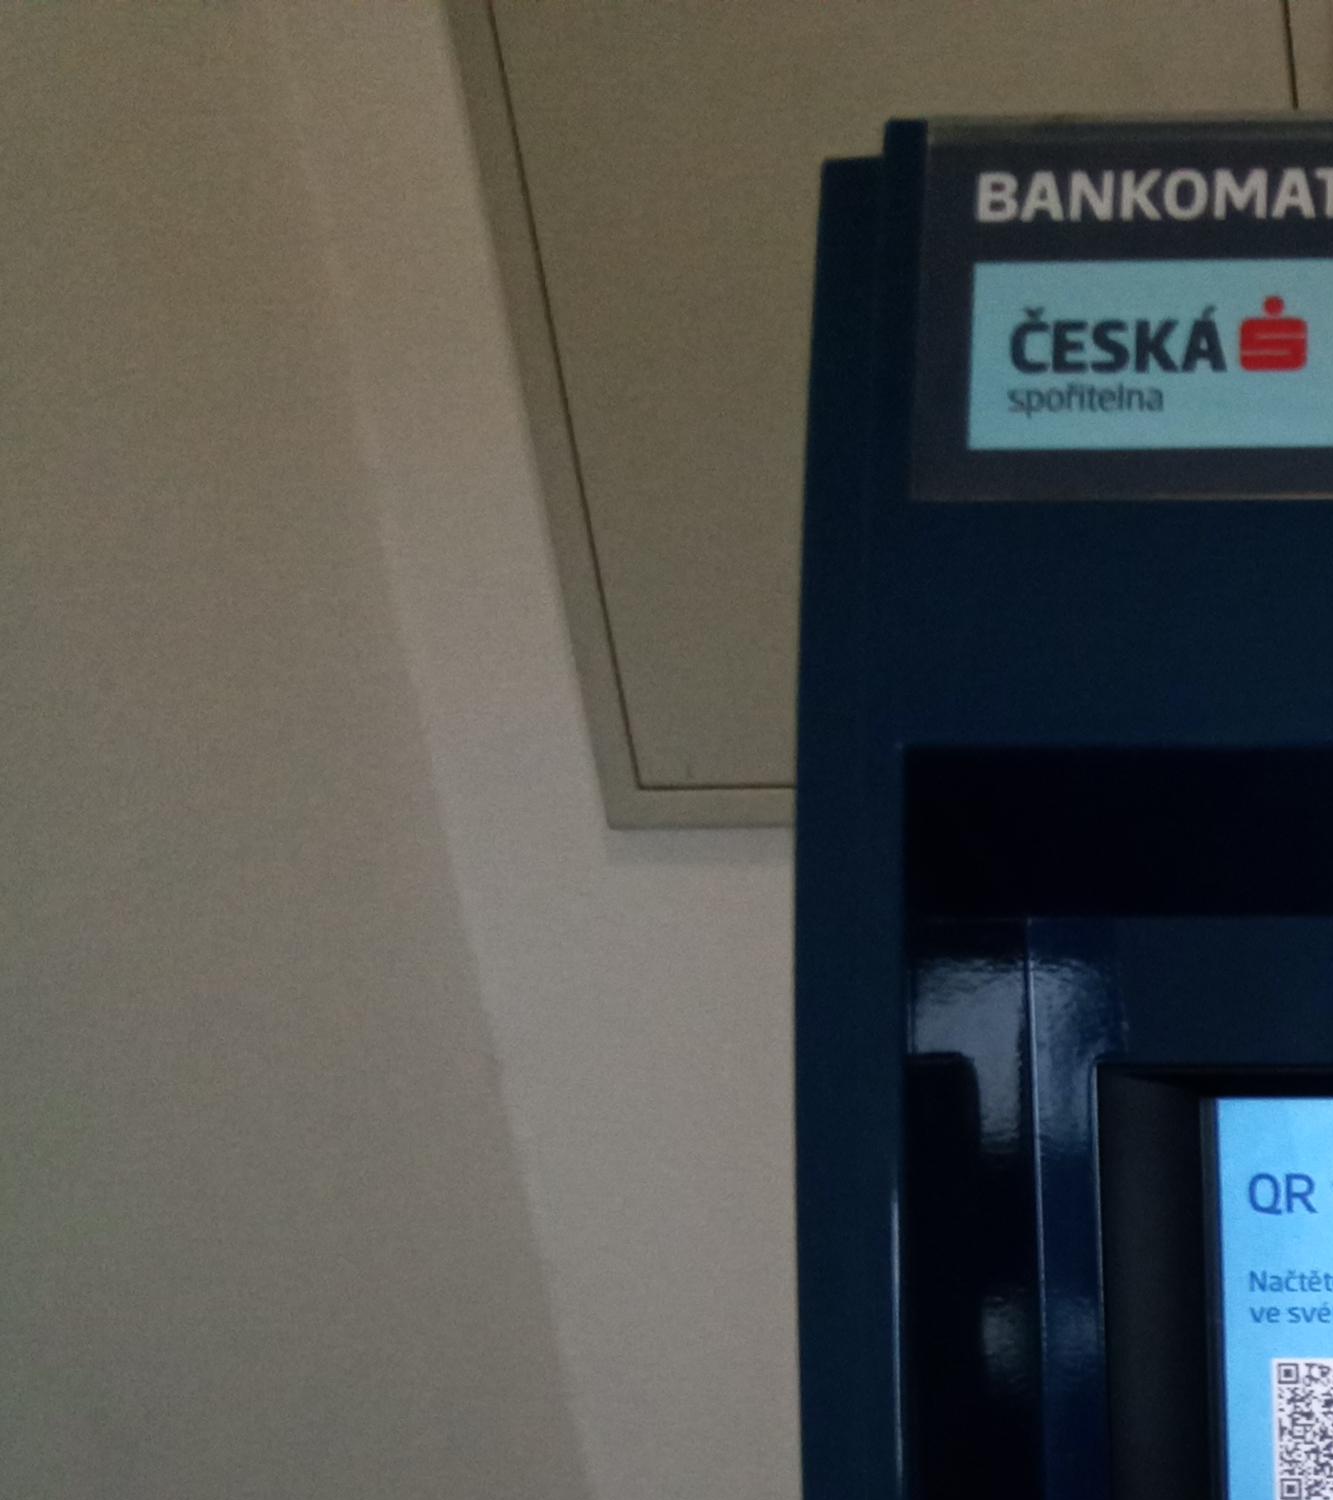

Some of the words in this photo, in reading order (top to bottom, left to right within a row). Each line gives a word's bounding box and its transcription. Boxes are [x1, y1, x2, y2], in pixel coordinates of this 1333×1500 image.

[1009, 306, 1228, 374] ČESKÁ
[1007, 382, 1164, 419] spořitelna
[1249, 1172, 1318, 1216] QR
[1250, 1306, 1280, 1324] ve
